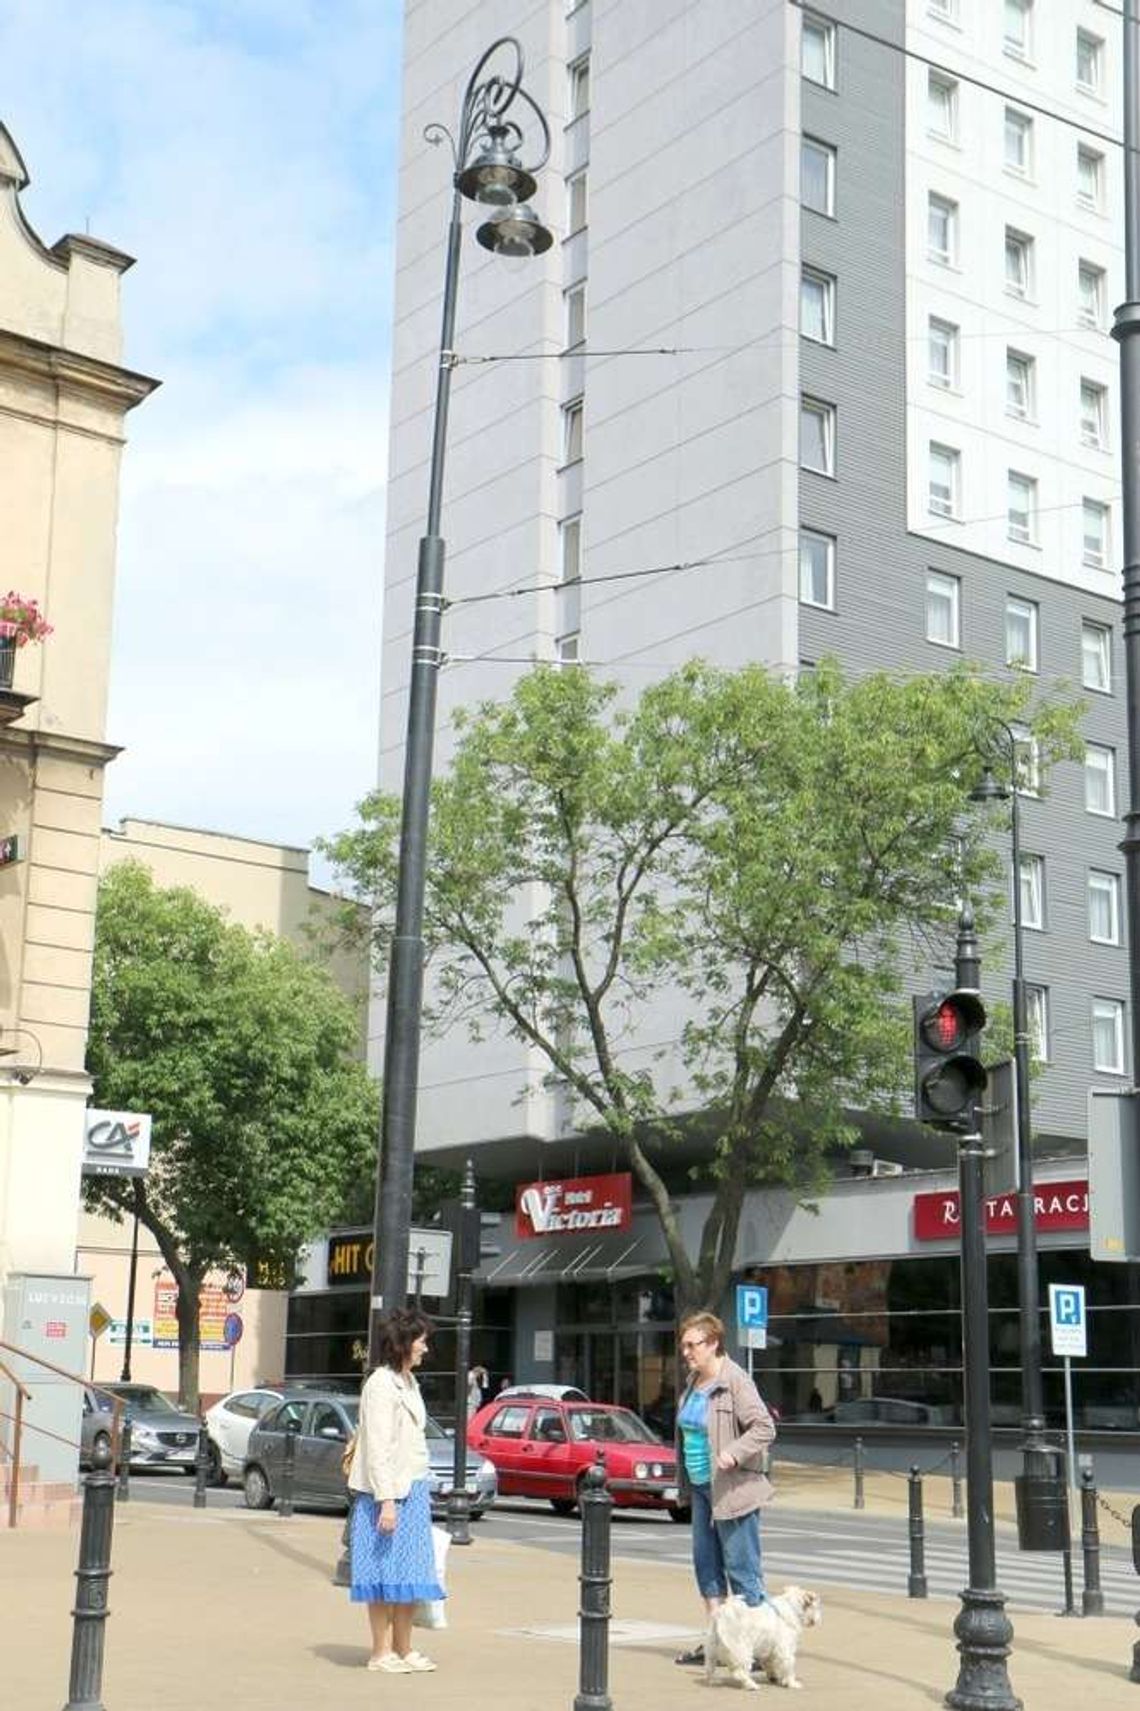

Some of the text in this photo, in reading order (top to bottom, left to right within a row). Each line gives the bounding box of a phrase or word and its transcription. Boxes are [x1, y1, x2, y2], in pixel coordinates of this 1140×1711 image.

[521, 1188, 622, 1232] Victoria
[943, 1194, 1089, 1224] RTARACJ
[334, 1243, 360, 1275] HIT
[744, 1290, 762, 1323] P
[1060, 1293, 1076, 1322] P
